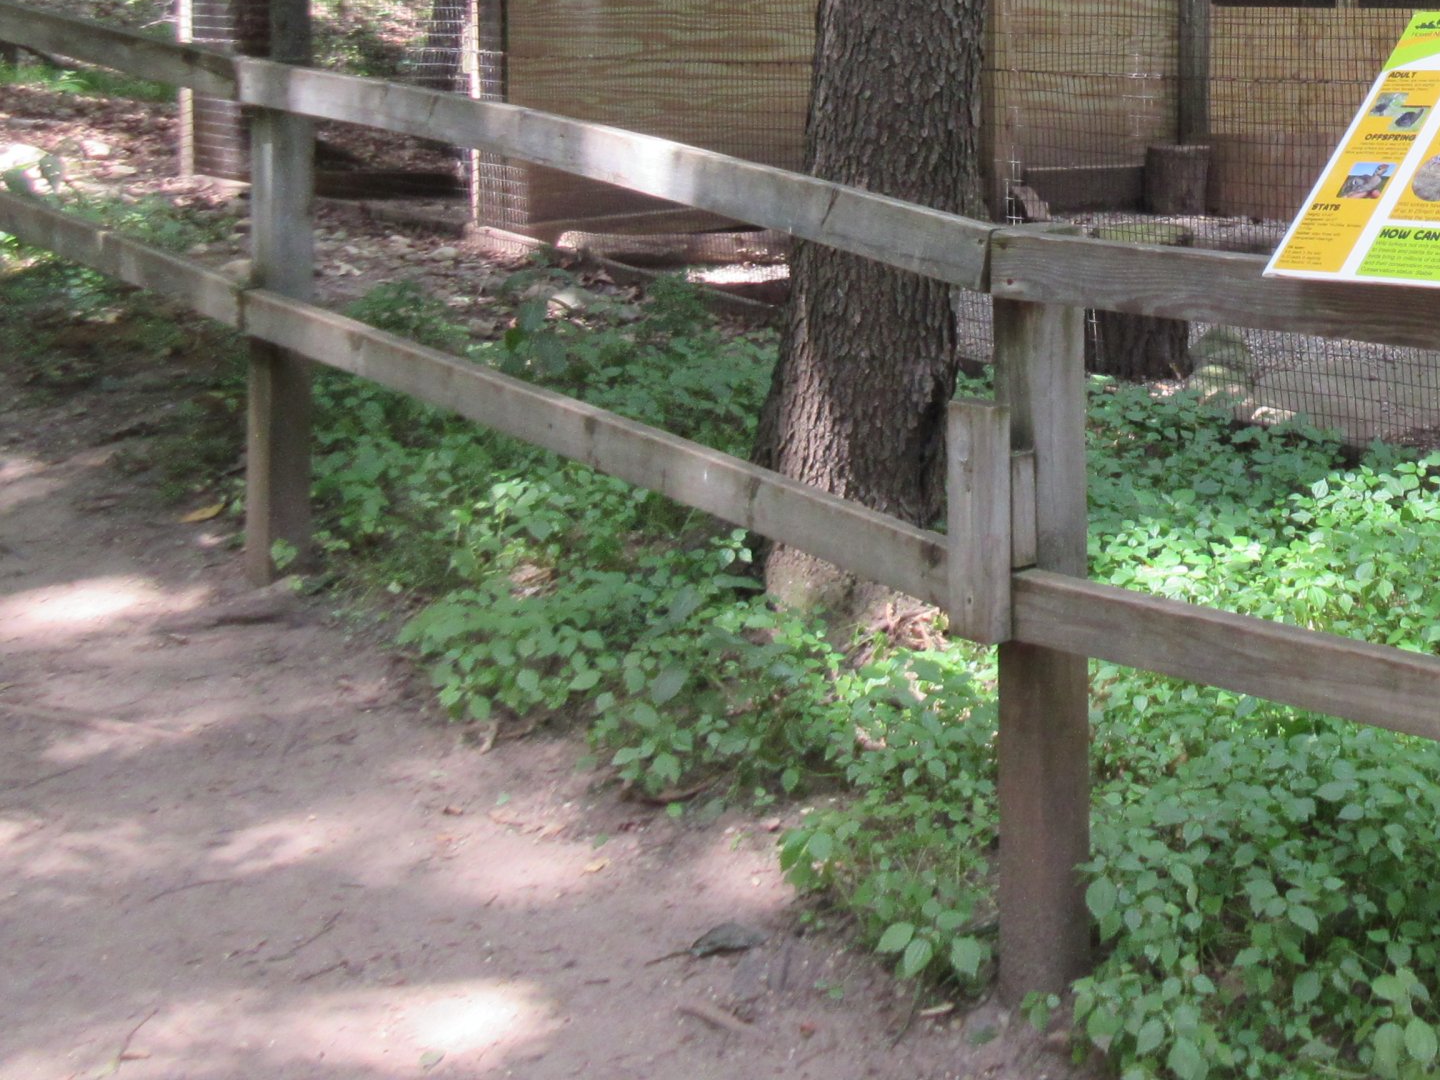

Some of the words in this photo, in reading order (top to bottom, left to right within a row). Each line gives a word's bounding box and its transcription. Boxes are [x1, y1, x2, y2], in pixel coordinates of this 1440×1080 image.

[1388, 71, 1417, 79] ADULT
[1364, 133, 1417, 141] OFFSPRING
[1312, 203, 1341, 211] STATS
[1380, 229, 1411, 239] HOW
